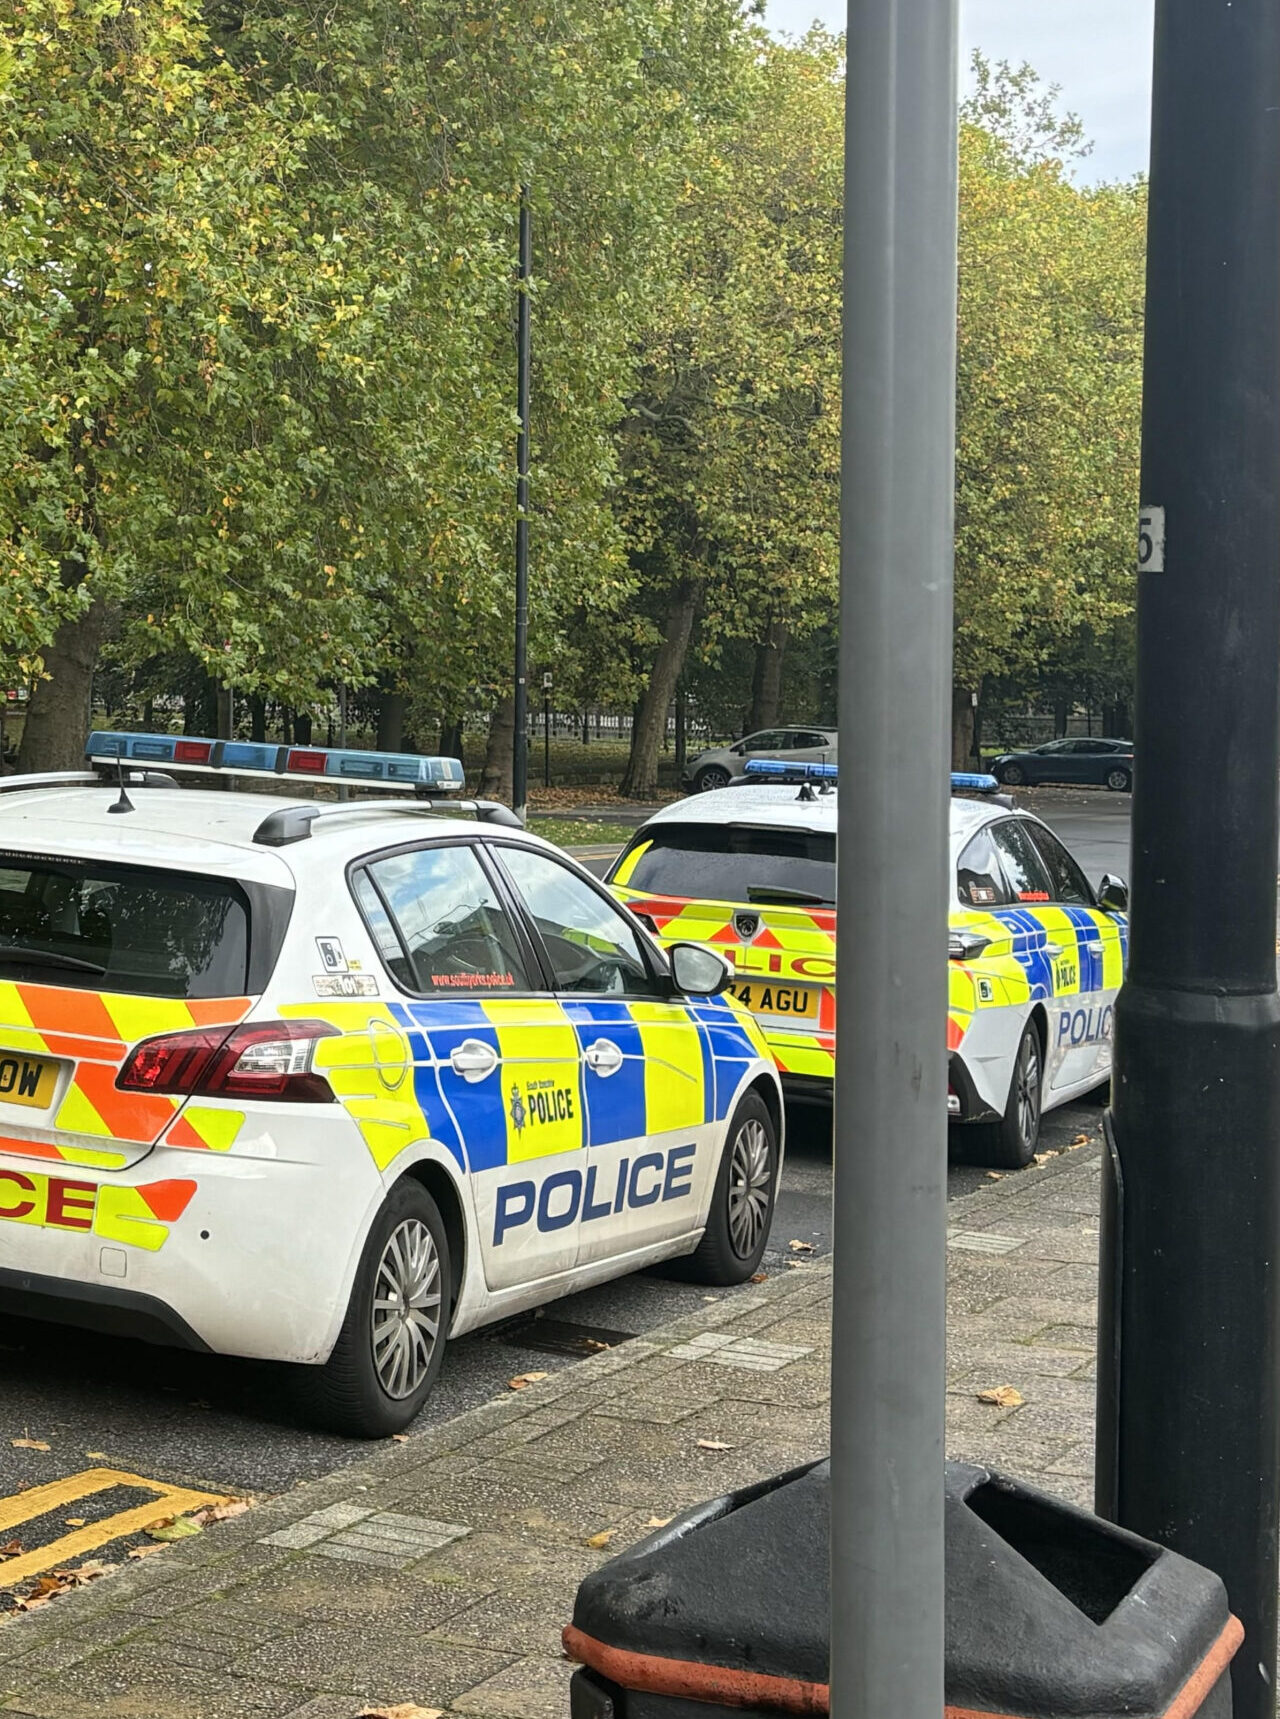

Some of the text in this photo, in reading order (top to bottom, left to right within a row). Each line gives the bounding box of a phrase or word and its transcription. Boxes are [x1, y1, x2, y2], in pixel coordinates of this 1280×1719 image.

[759, 988, 808, 1013] AGU
[1058, 1004, 1114, 1047] POLIC
[527, 1088, 574, 1127] POLICE
[492, 1143, 697, 1247] POLICE
